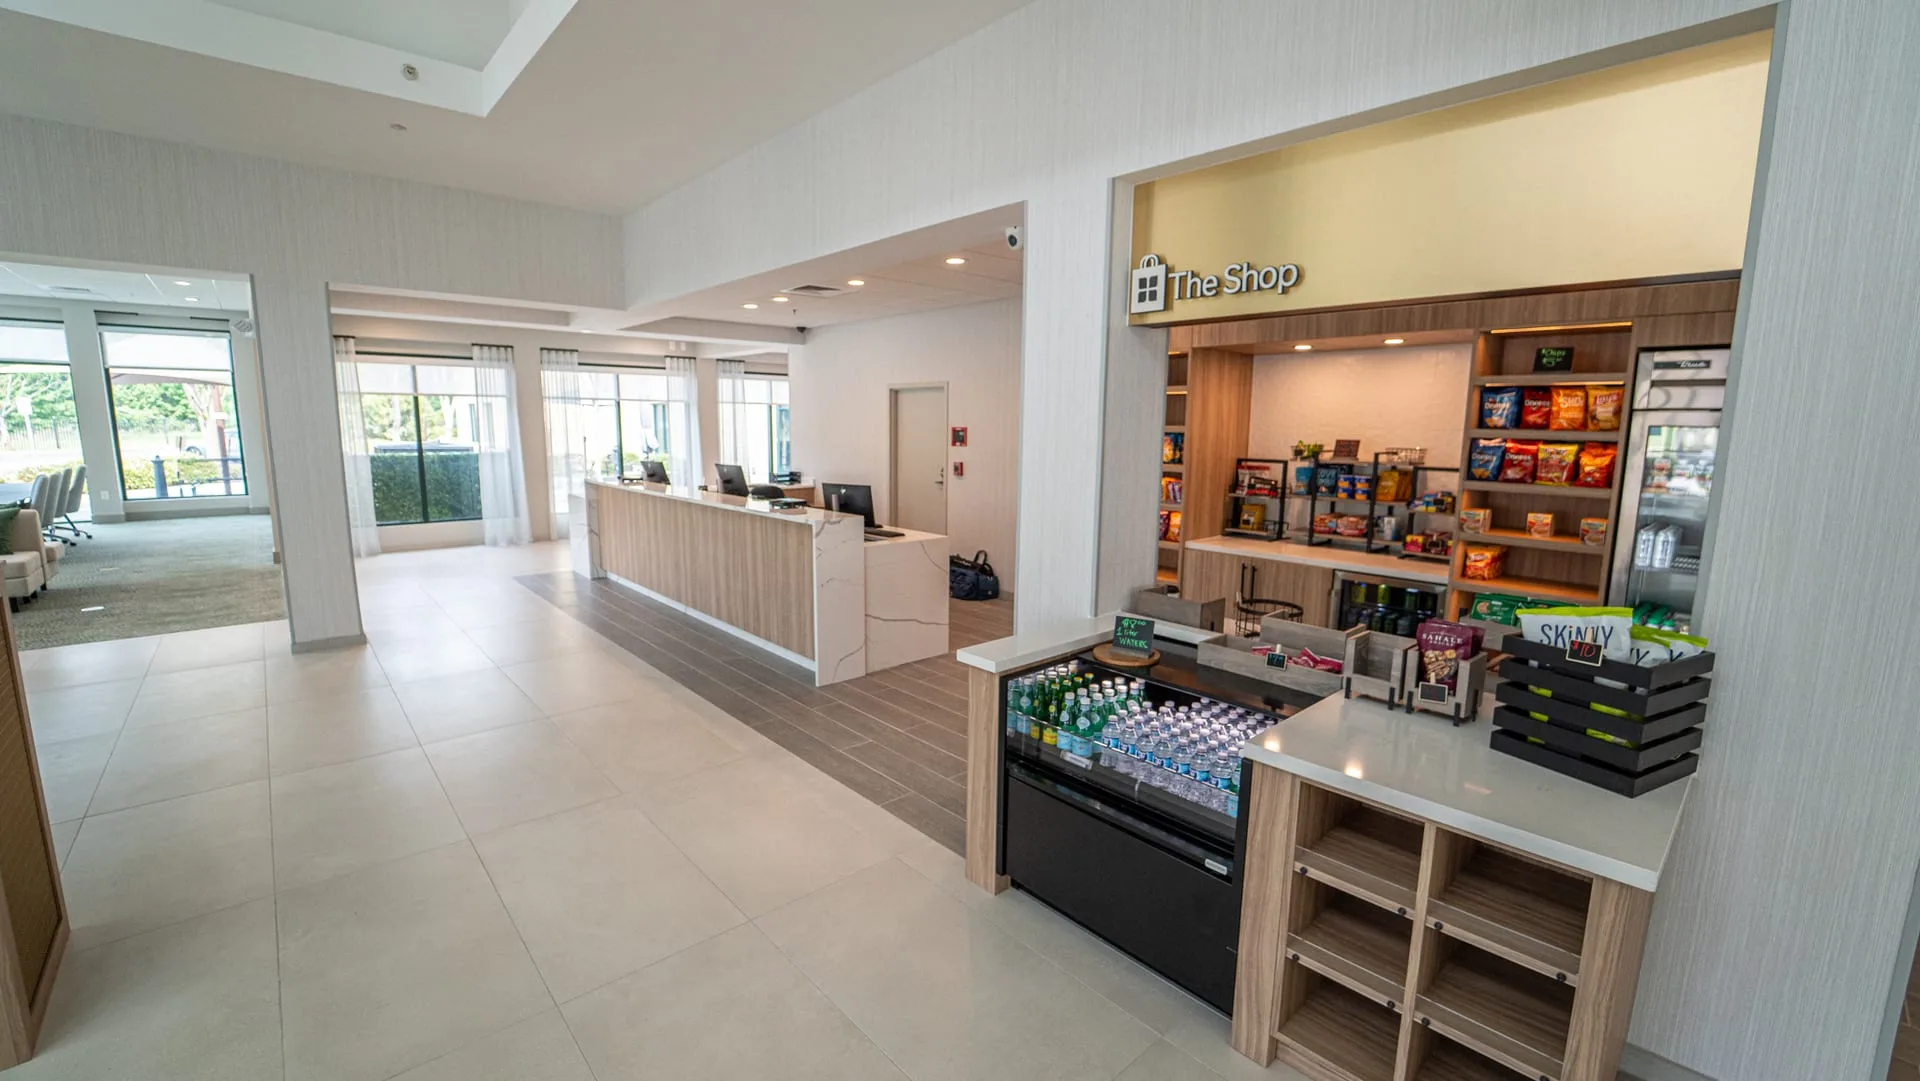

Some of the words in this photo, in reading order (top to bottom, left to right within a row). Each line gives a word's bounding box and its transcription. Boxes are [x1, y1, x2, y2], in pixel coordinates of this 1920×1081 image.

[1168, 270, 1219, 300] The
[1223, 261, 1299, 295] Shop
[1422, 633, 1463, 645] SAHALE
